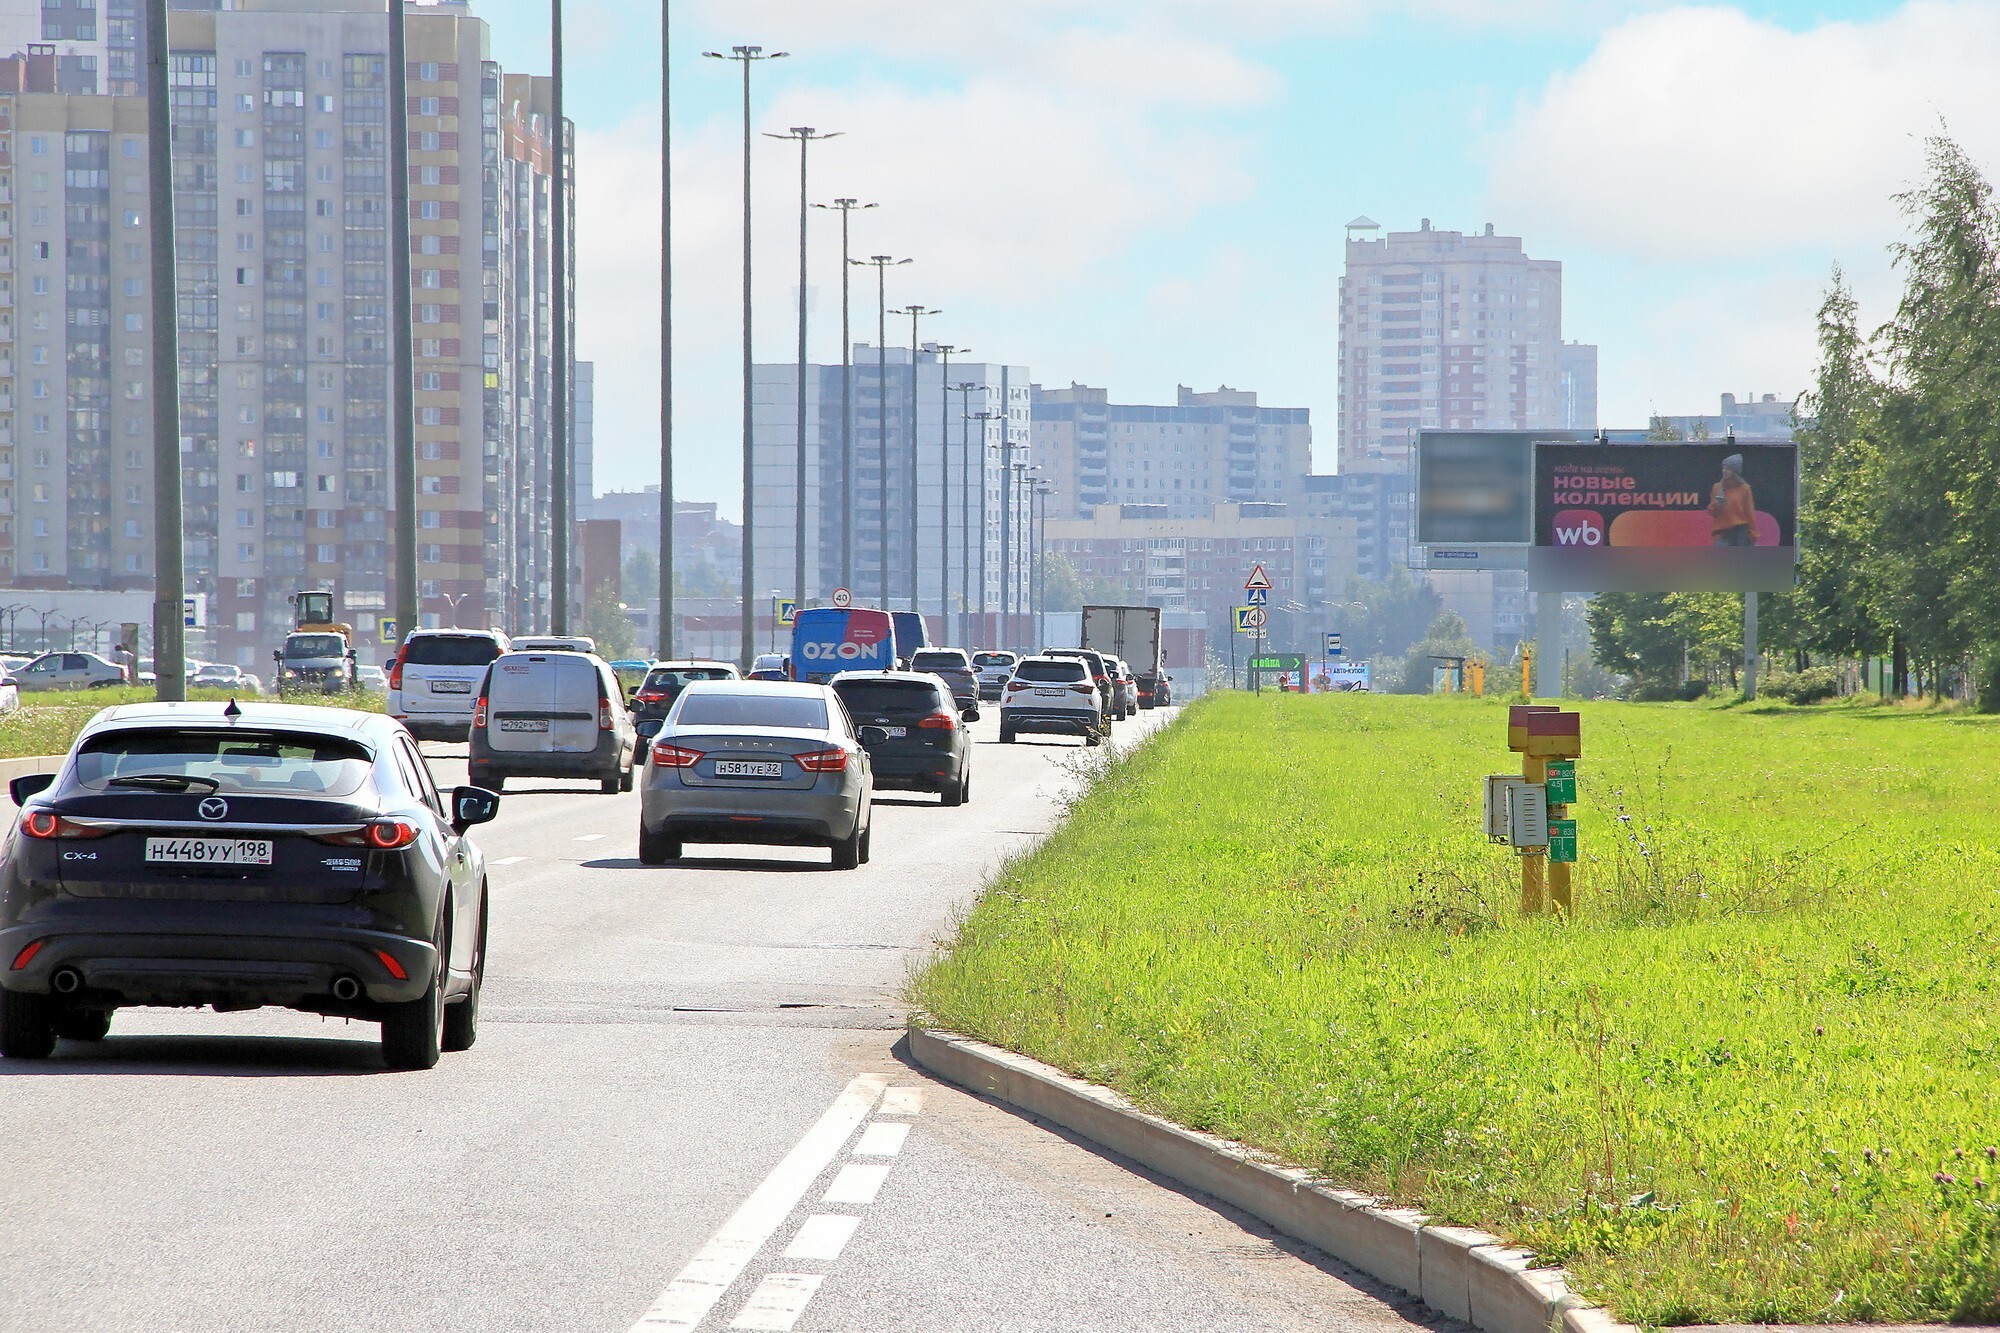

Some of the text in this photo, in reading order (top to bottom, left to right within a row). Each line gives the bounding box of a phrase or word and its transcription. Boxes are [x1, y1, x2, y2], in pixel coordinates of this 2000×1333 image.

[1556, 520, 1600, 546] wb
[835, 594, 848, 602] 40
[803, 641, 878, 660] OZON
[766, 763, 779, 773] 32
[63, 851, 98, 860] CX-4
[236, 841, 267, 857] 198
